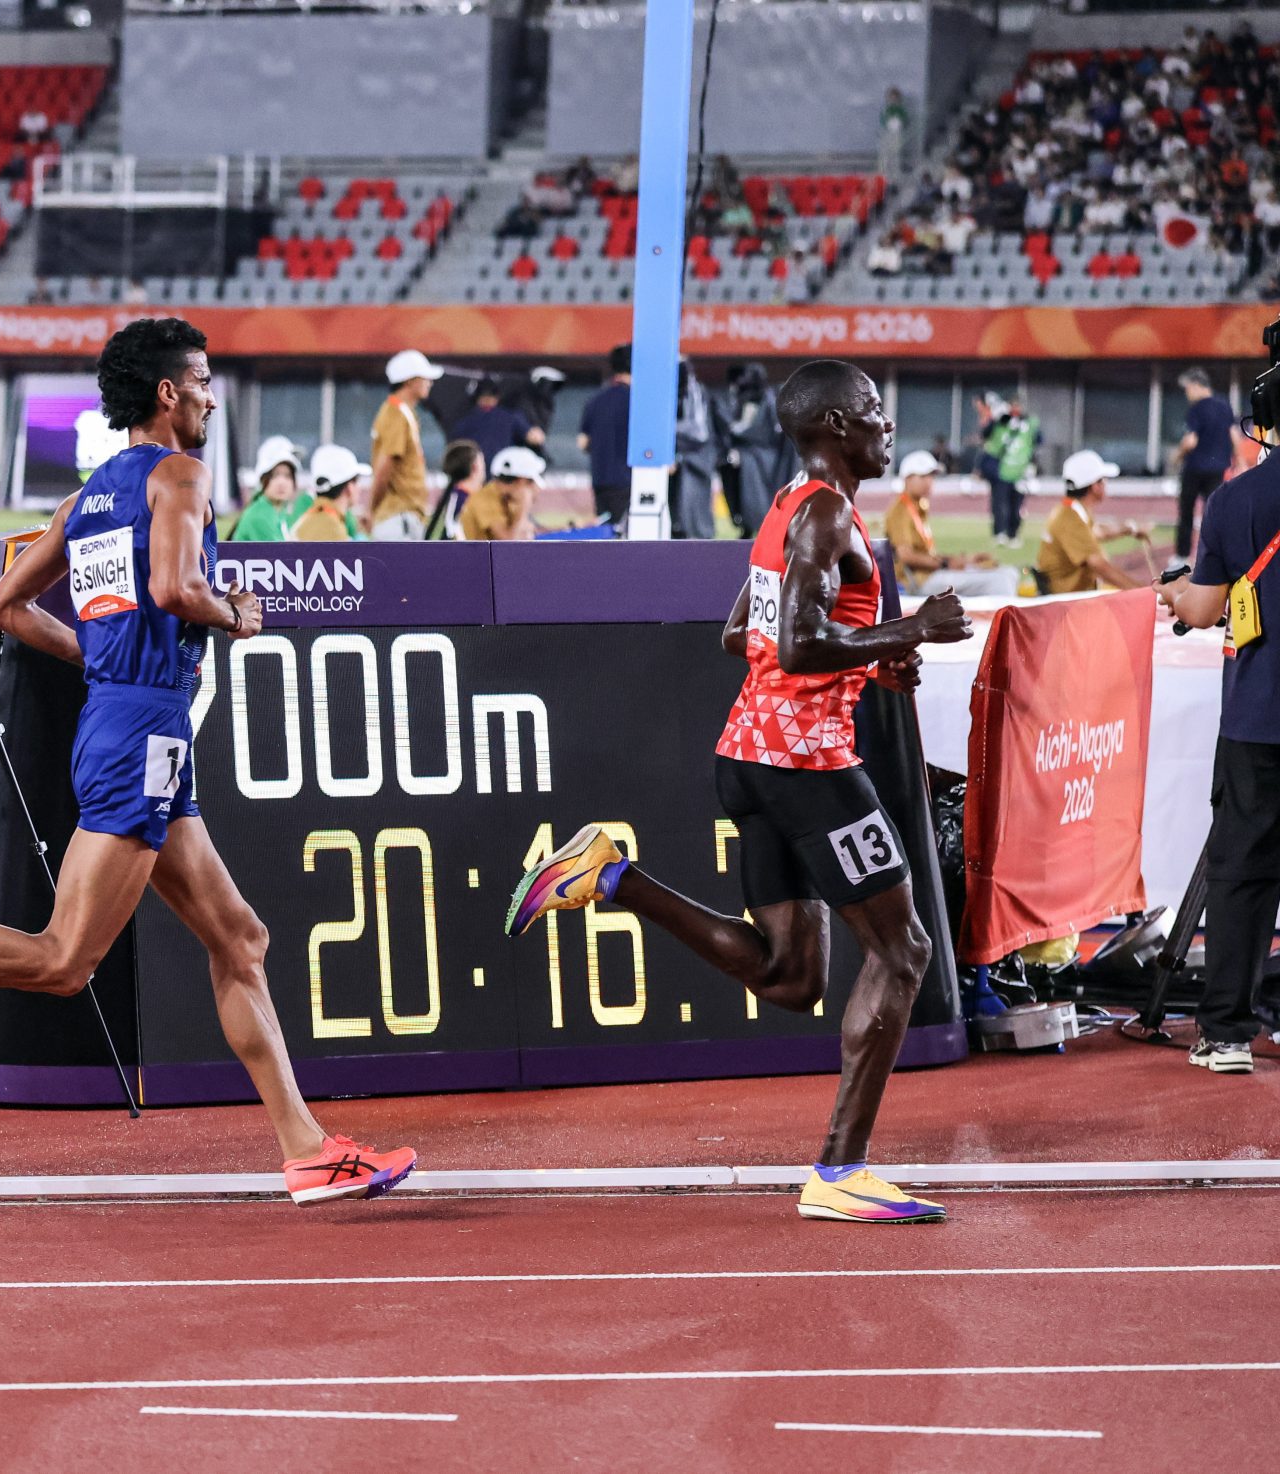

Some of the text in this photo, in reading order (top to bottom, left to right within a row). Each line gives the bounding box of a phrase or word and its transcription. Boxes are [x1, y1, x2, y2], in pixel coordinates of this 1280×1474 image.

[853, 312, 933, 343] 2026
[81, 493, 115, 515] INDIA
[80, 536, 118, 556] BORNAN
[72, 556, 128, 593] G.SINGH
[116, 583, 129, 595] 322
[214, 559, 364, 592] ORNAN
[1238, 598, 1247, 621] 795
[766, 625, 778, 636] 212
[1035, 719, 1125, 774] Aichi-Nagoya
[1060, 774, 1095, 825] 2026
[838, 823, 893, 876] 13
